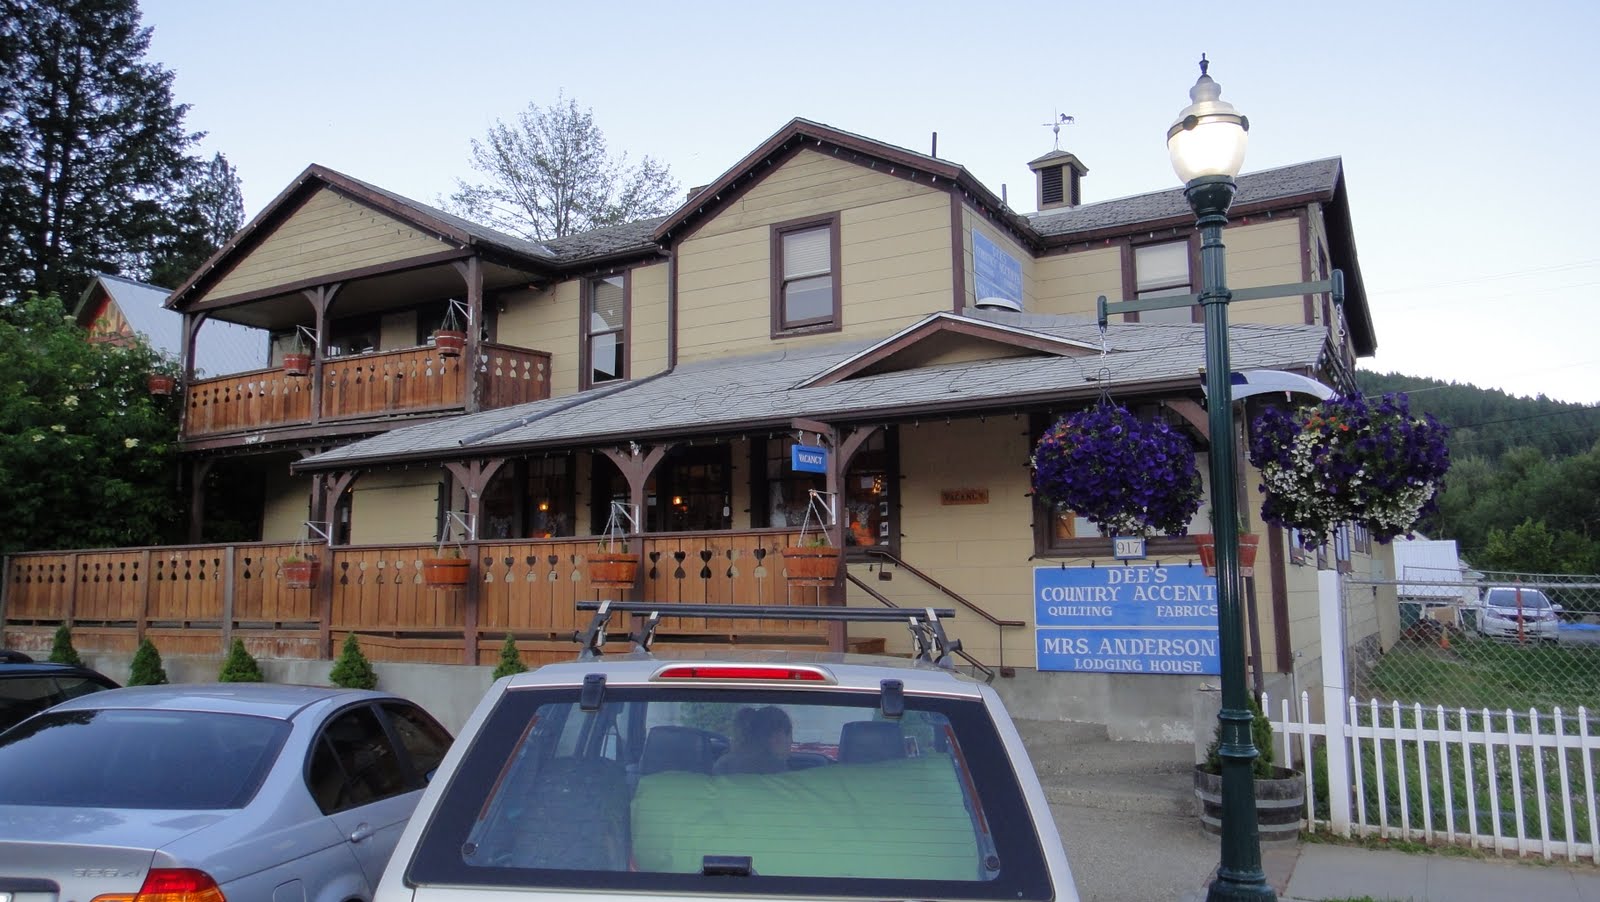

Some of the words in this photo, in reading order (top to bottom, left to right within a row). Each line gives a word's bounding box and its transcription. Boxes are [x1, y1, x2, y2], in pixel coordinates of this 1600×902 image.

[798, 453, 823, 465] VACANCY
[1116, 542, 1141, 555] 917
[1107, 567, 1168, 584] DEE'S
[1041, 586, 1121, 602] COUNTRY
[1133, 585, 1217, 601] ACCENT
[1048, 606, 1113, 617] QUILTING
[1156, 605, 1218, 617] FABRICS
[1043, 638, 1091, 655] MRS.
[1096, 638, 1217, 656] ANDERSON
[1074, 658, 1143, 671] LODGING
[1150, 660, 1203, 673] HOUSE
